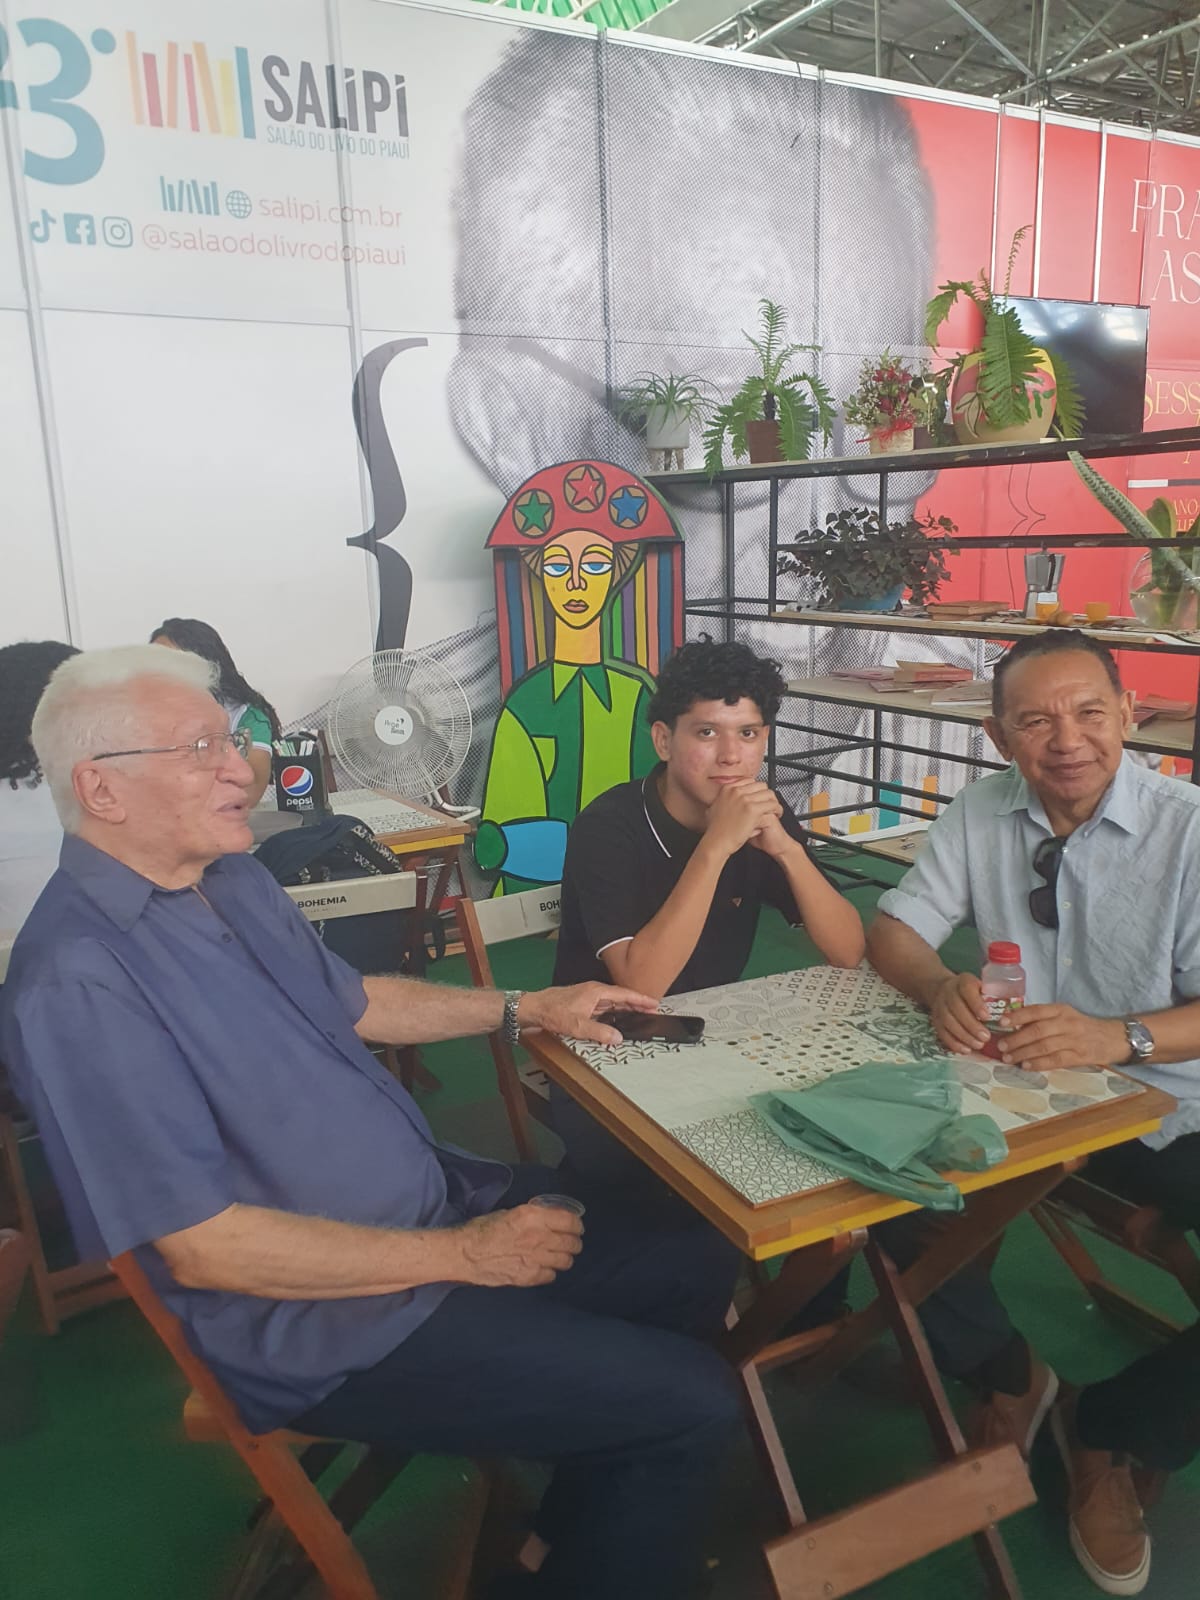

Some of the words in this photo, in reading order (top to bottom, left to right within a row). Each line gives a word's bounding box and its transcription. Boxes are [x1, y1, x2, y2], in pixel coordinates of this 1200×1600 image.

[267, 124, 305, 147] SALÃO
[309, 131, 325, 150] DO
[360, 137, 376, 156] DO
[259, 196, 402, 228] salipi.com.br
[142, 222, 406, 266] @salaodolivrodopiaui
[286, 796, 313, 807] pepsi
[297, 896, 347, 909] BOHEMIA
